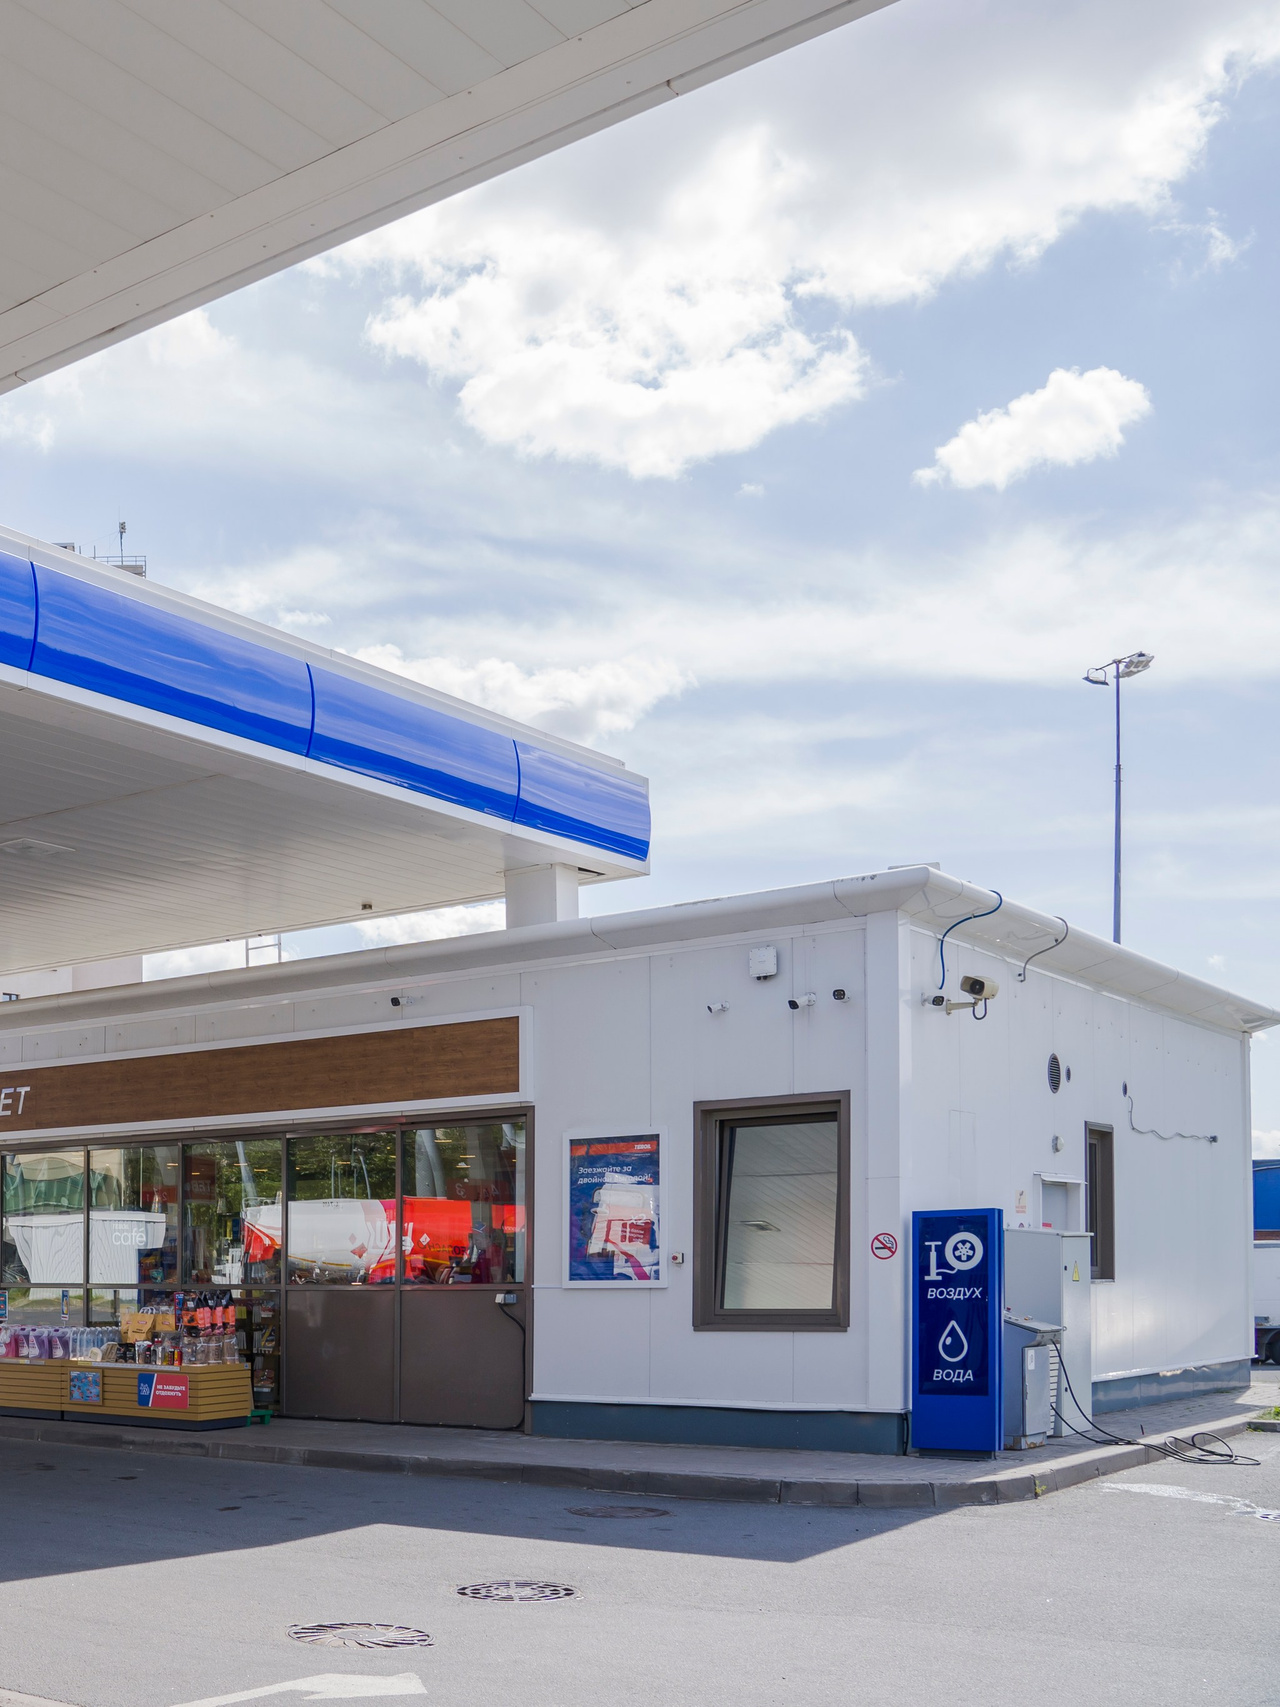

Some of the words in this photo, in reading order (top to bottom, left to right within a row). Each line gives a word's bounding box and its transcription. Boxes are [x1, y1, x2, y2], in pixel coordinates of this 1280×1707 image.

[578, 1166, 621, 1174] Заезжайте
[112, 1228, 147, 1247] café
[927, 1287, 983, 1300] ВОЗДУХ
[933, 1369, 974, 1383] ВОДА
